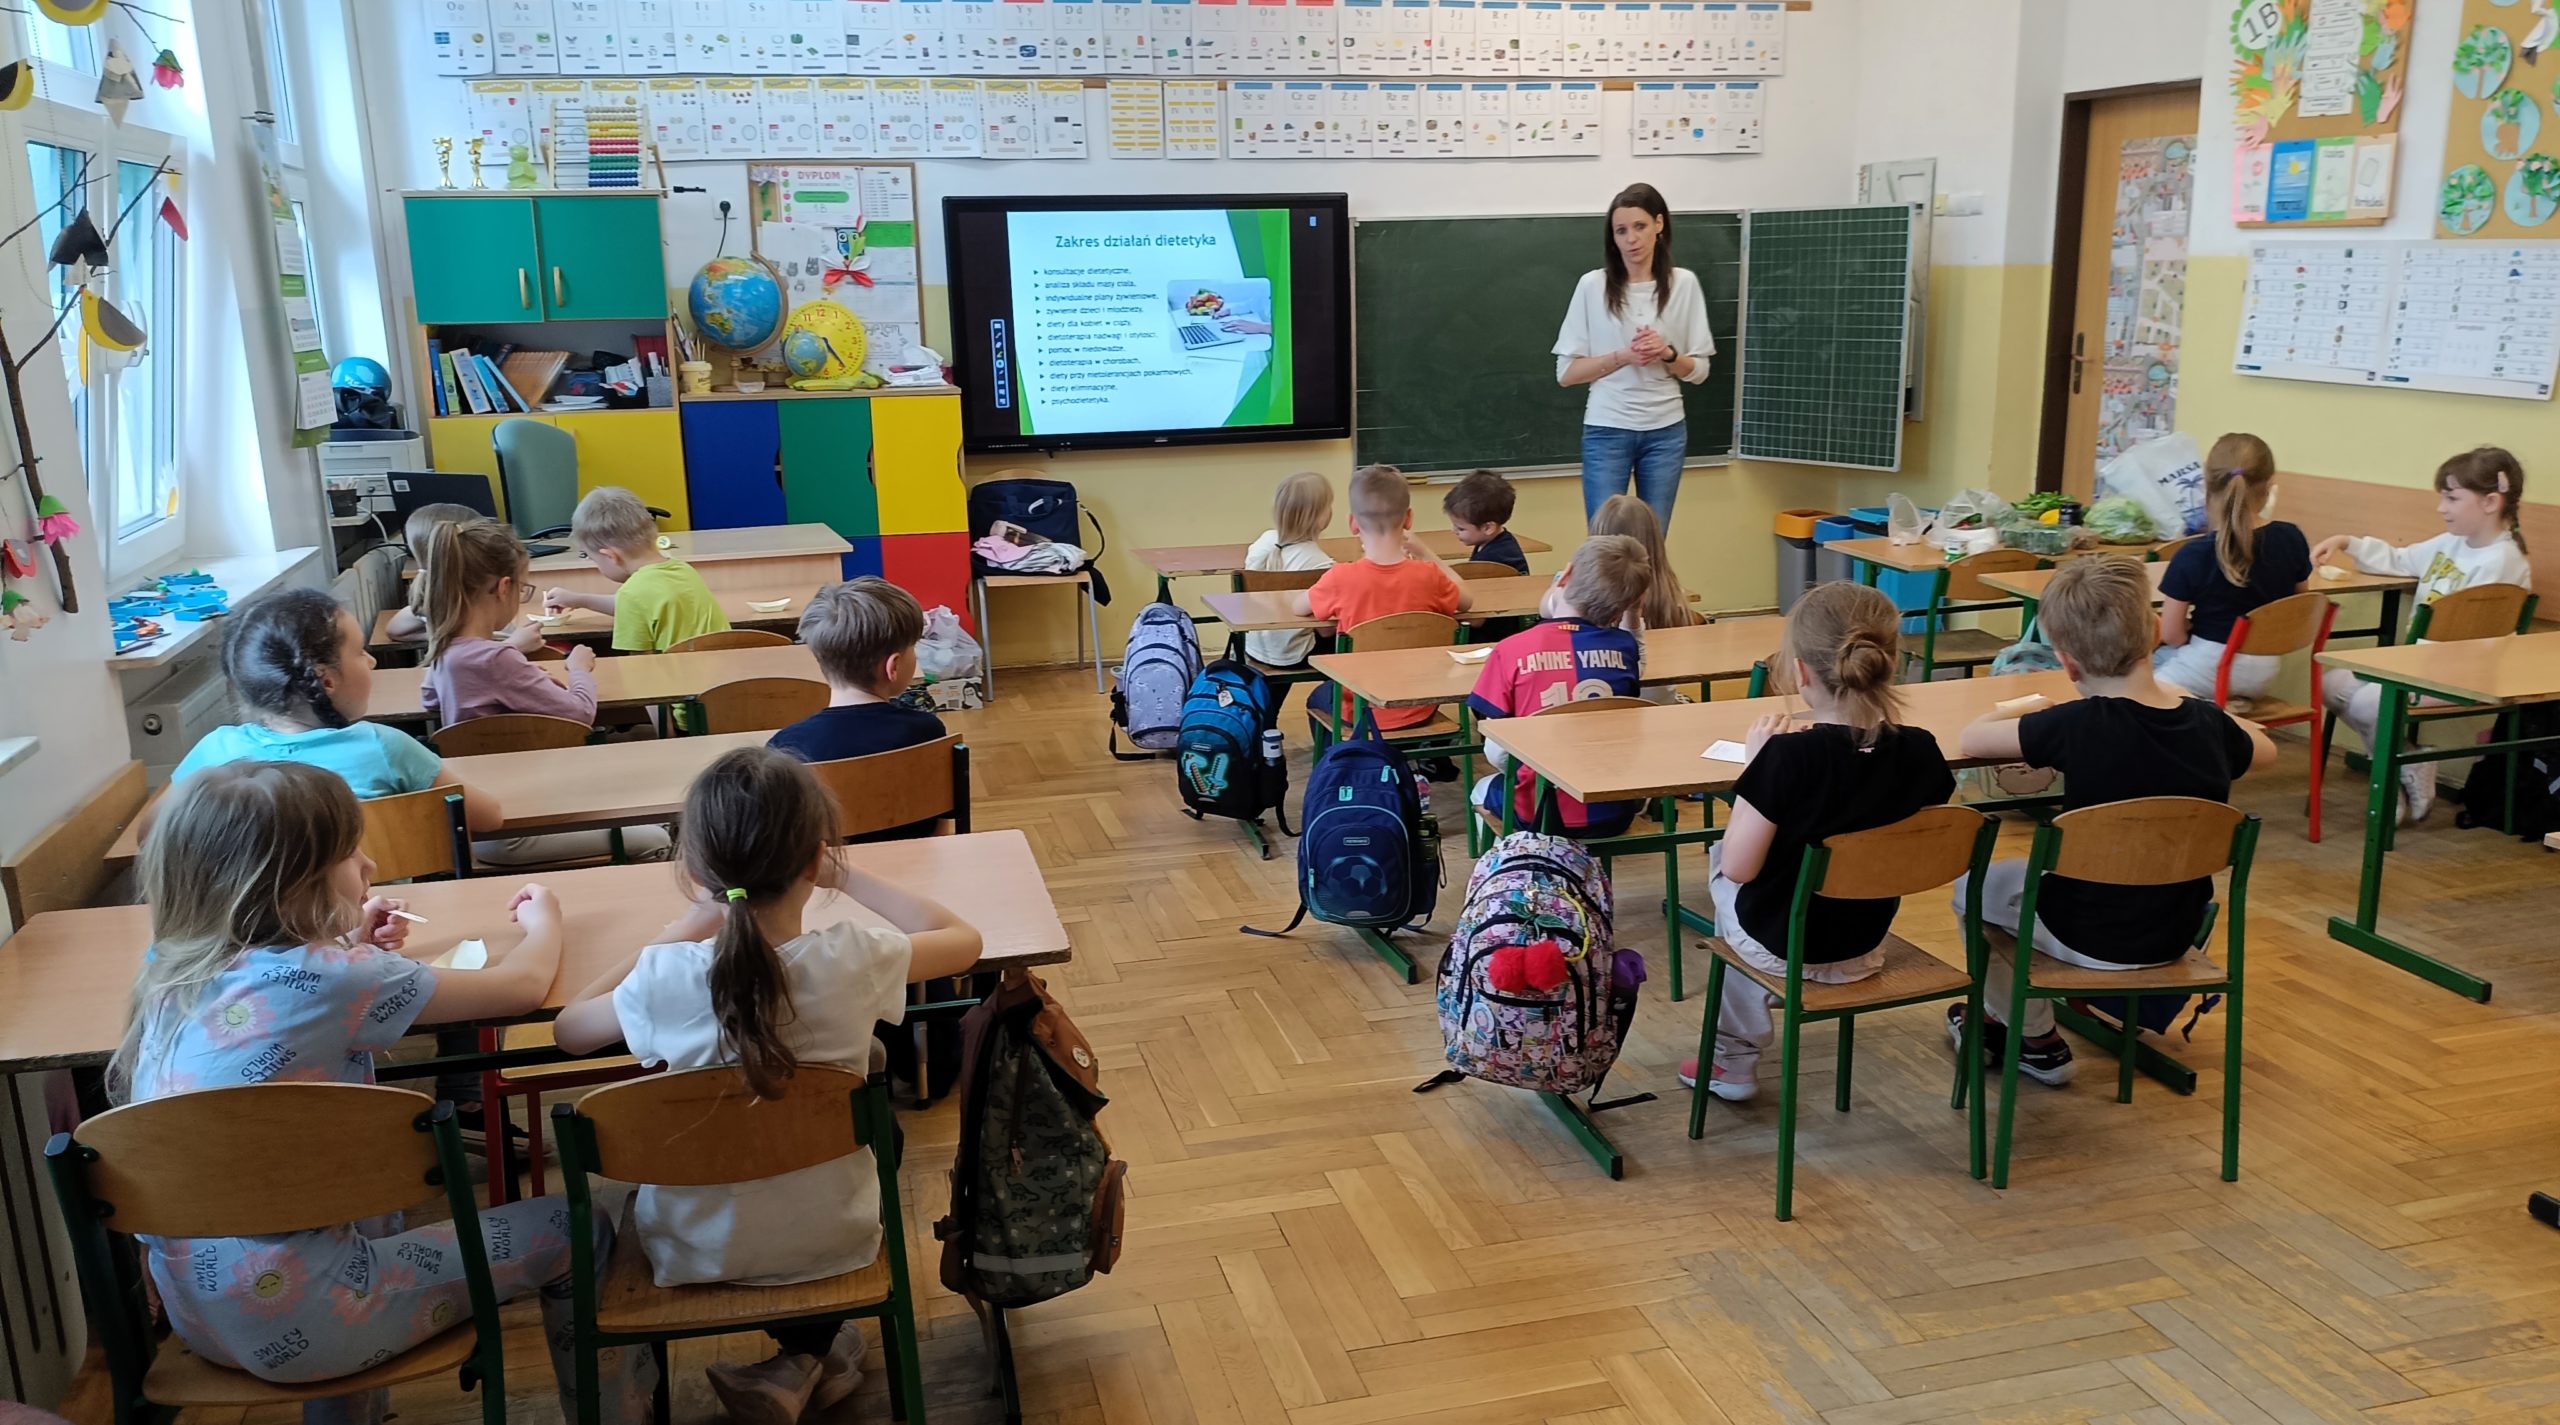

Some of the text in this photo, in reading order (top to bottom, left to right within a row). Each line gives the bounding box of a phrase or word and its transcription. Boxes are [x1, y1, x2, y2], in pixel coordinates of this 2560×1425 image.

[2243, 2, 2279, 43] 1B
[797, 171, 841, 180] DYPLOM
[1055, 234, 1216, 248] Zakres działań dietetyka
[803, 313, 811, 322] 11
[815, 308, 825, 317] 12
[845, 321, 852, 330] 2
[852, 337, 858, 345] 3
[1517, 649, 1627, 675] LAMINE YAMAL
[376, 988, 418, 1024] WORLD
[241, 1043, 286, 1078] WORLD
[501, 1217, 512, 1260] WORLD
[193, 1252, 206, 1291] SMILE
[397, 1249, 440, 1275] SMILEY
[253, 1328, 303, 1361] SMILEY
[263, 1339, 310, 1370] WORLD
